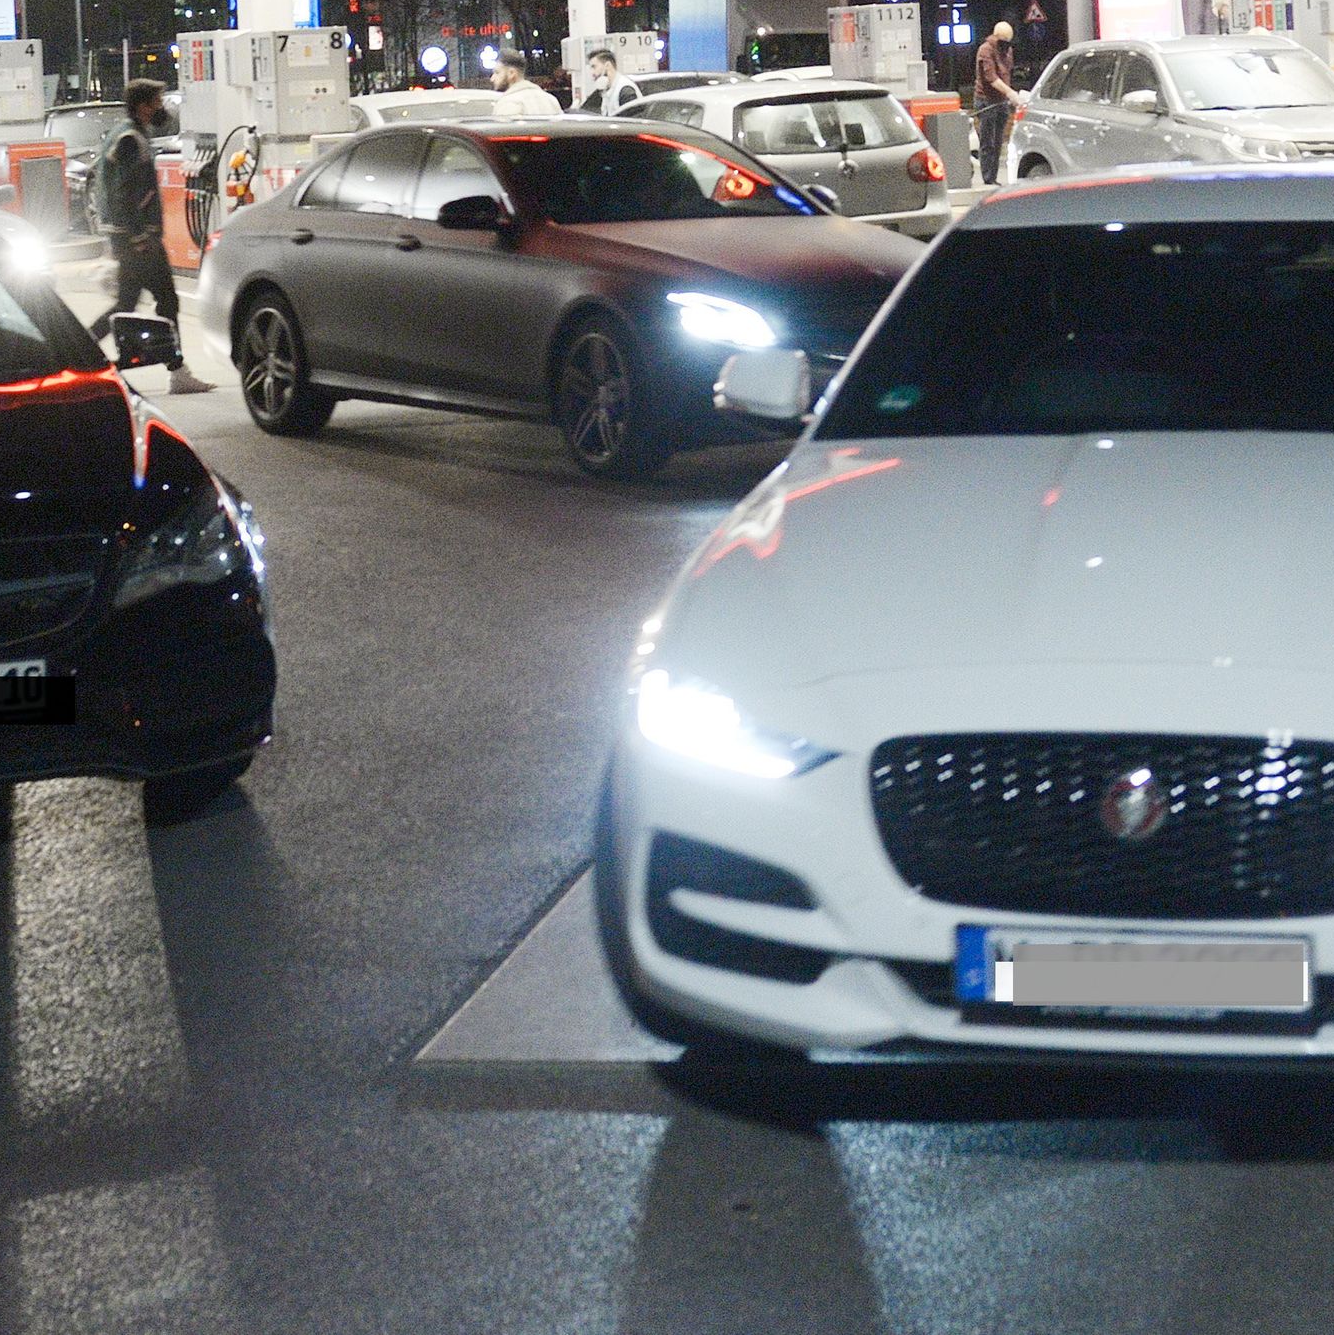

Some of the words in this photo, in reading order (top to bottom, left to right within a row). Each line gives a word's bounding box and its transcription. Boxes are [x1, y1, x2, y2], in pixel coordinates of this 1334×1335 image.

[898, 8, 914, 20] 12
[276, 35, 289, 53] 7
[330, 31, 343, 50] 8
[619, 36, 627, 47] 9
[637, 35, 652, 46] 10
[25, 43, 35, 58] 4
